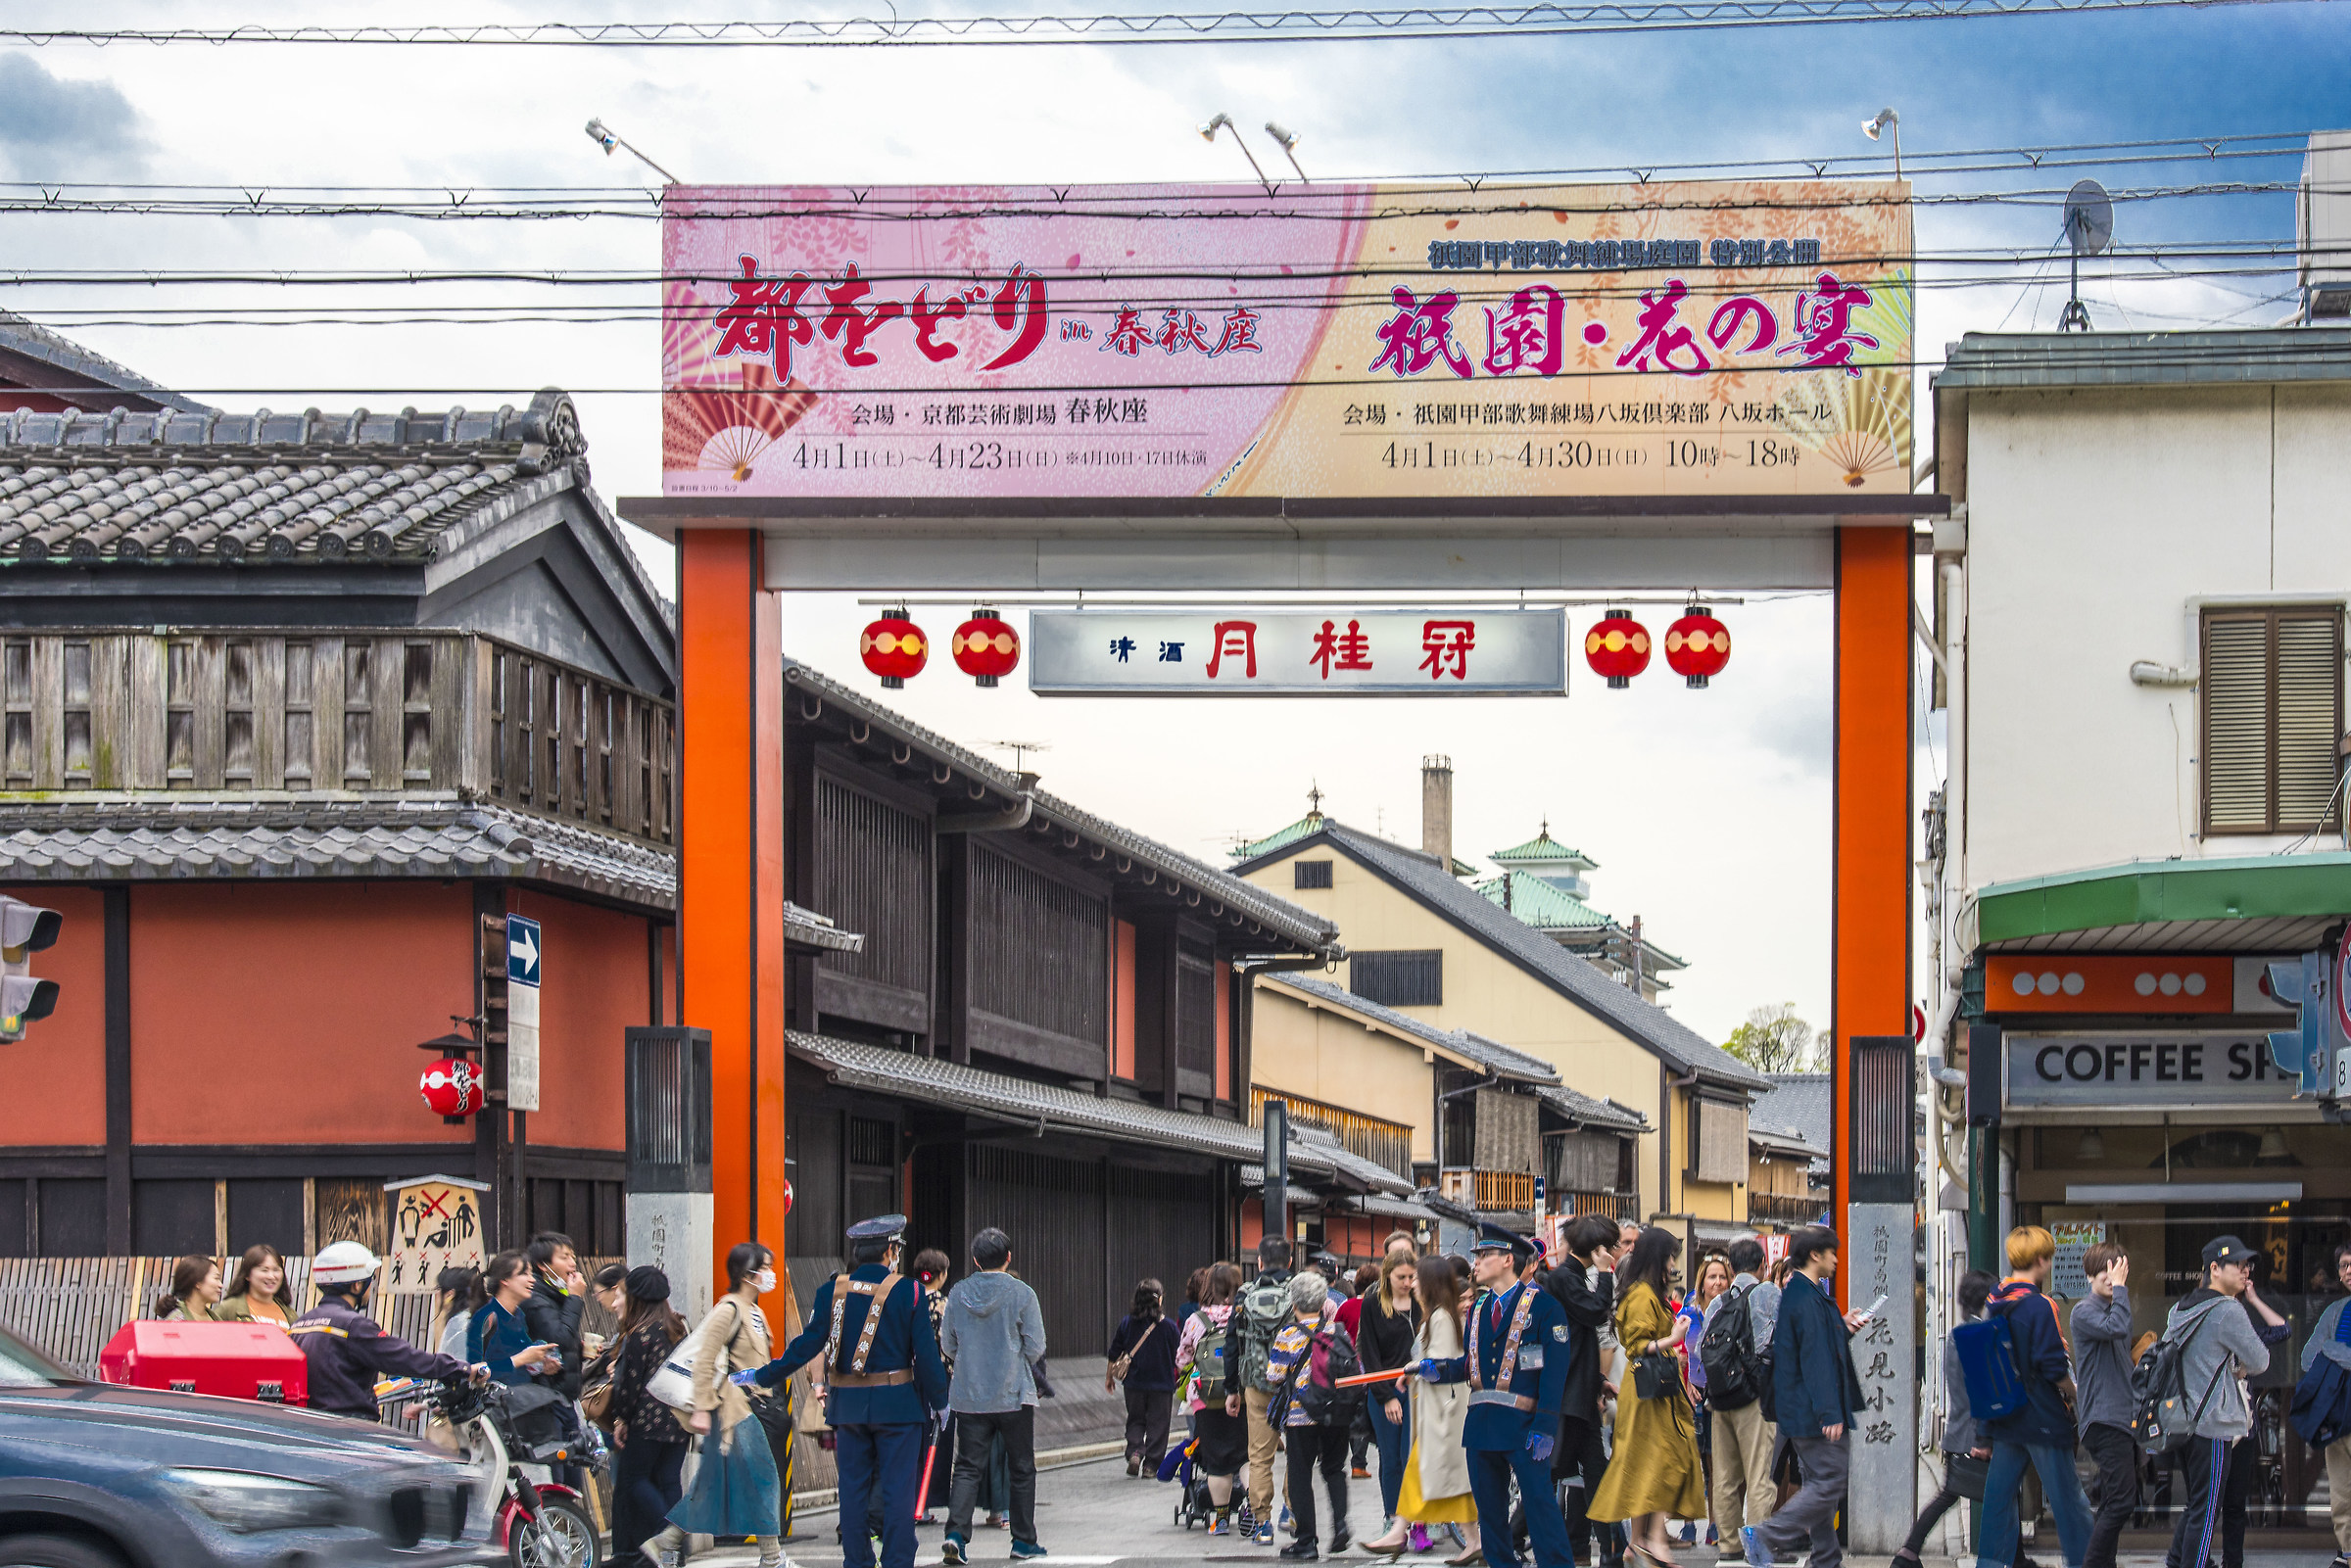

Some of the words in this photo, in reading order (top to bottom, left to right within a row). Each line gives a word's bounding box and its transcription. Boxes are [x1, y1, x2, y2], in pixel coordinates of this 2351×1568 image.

[1709, 239, 1821, 267] 特別公開
[713, 253, 1049, 385] 都をどり
[1061, 318, 1092, 342] in
[1099, 303, 1263, 358] 春秋座
[851, 404, 1057, 426] 会場・京都芸術劇場
[1065, 397, 1148, 424] 春秋座
[1719, 402, 1832, 425] 八坂ホール
[1109, 636, 1185, 664] 清酒
[1205, 619, 1476, 680] 月桂冠
[2035, 1044, 2203, 1081] COFFEE
[1865, 1316, 1897, 1446] 花見小路
